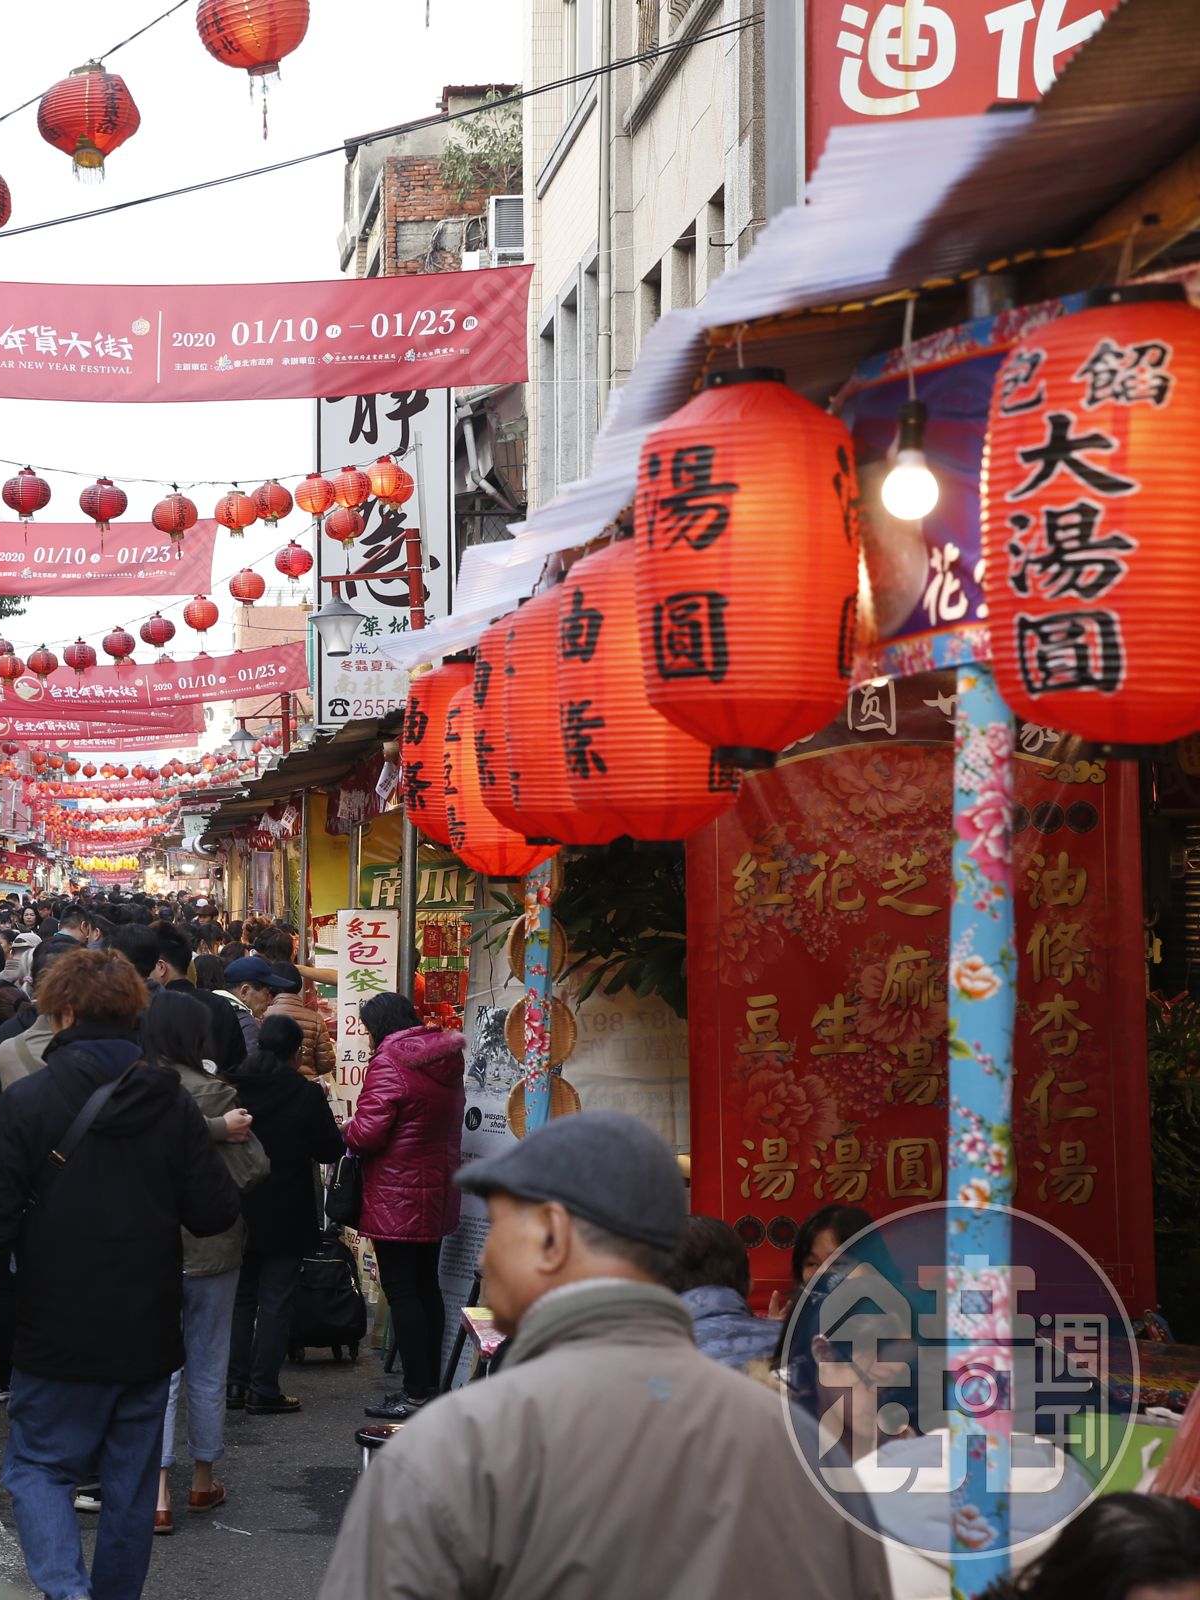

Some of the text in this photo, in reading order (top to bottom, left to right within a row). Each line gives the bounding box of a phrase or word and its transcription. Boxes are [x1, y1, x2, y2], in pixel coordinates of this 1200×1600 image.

[172, 331, 215, 348] 2020
[231, 317, 319, 346] 01/10
[370, 308, 457, 338] 01/23
[18, 360, 44, 370] NEW
[48, 362, 76, 372] YEAR
[80, 363, 133, 374] FESTIVAL
[33, 546, 87, 564] 01/10
[117, 545, 171, 564] 01/23
[644, 444, 740, 684] 湯圓
[1004, 412, 1142, 698] 大湯圓
[49, 684, 138, 699] 台北年貨大街
[153, 664, 276, 692] 2020 01/10 01/23
[345, 916, 391, 993] 紅包袋
[732, 851, 801, 1203] 紅豆湯
[804, 850, 871, 1203] 花生湯
[877, 850, 947, 1202] 芝麻湯圓
[1025, 851, 1099, 1206] 油條杏仁湯
[490, 1121, 507, 1129] show
